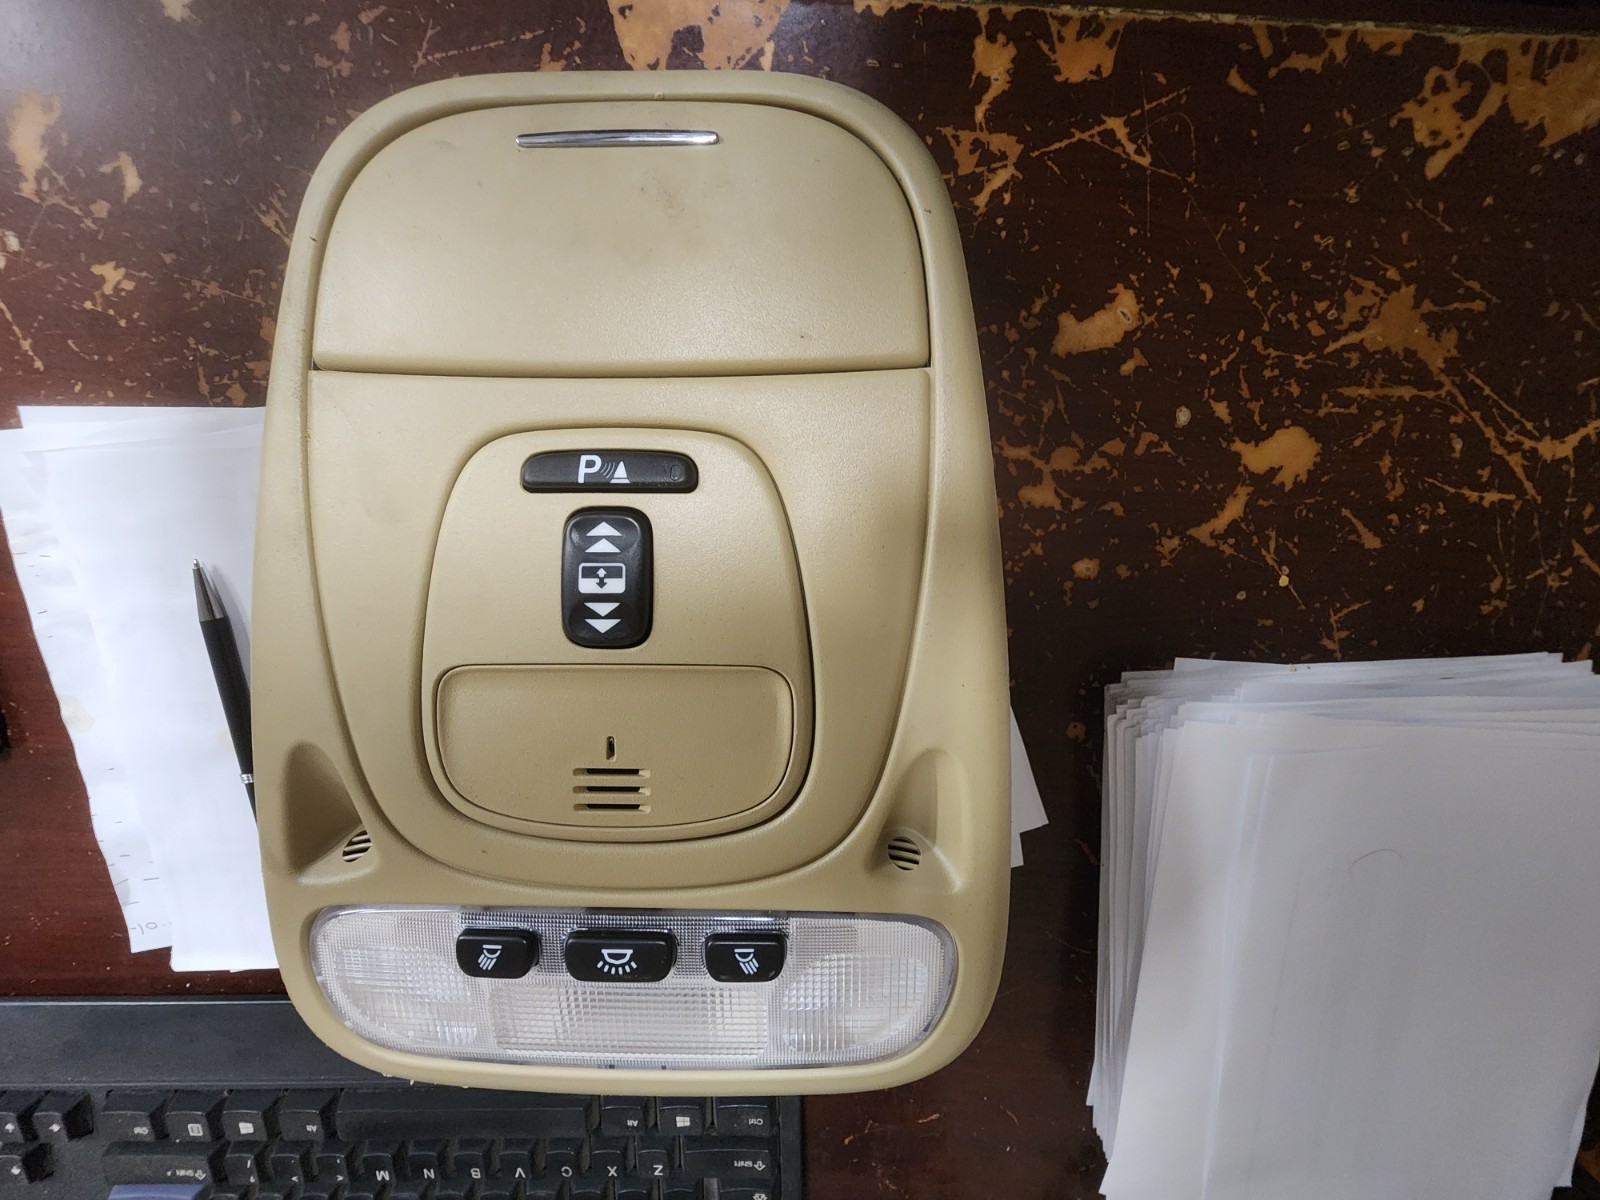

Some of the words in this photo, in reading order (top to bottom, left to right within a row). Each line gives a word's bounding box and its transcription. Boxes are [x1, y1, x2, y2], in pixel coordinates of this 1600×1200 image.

[577, 454, 603, 484] P
[748, 1118, 764, 1126] Ctrl
[733, 1159, 753, 1168] Shift
[375, 1170, 390, 1182] M
[423, 1168, 435, 1179] N
[470, 1167, 481, 1179] B
[514, 1167, 526, 1179] V
[560, 1166, 573, 1178] C
[606, 1165, 618, 1177] X
[652, 1164, 664, 1176] Z
